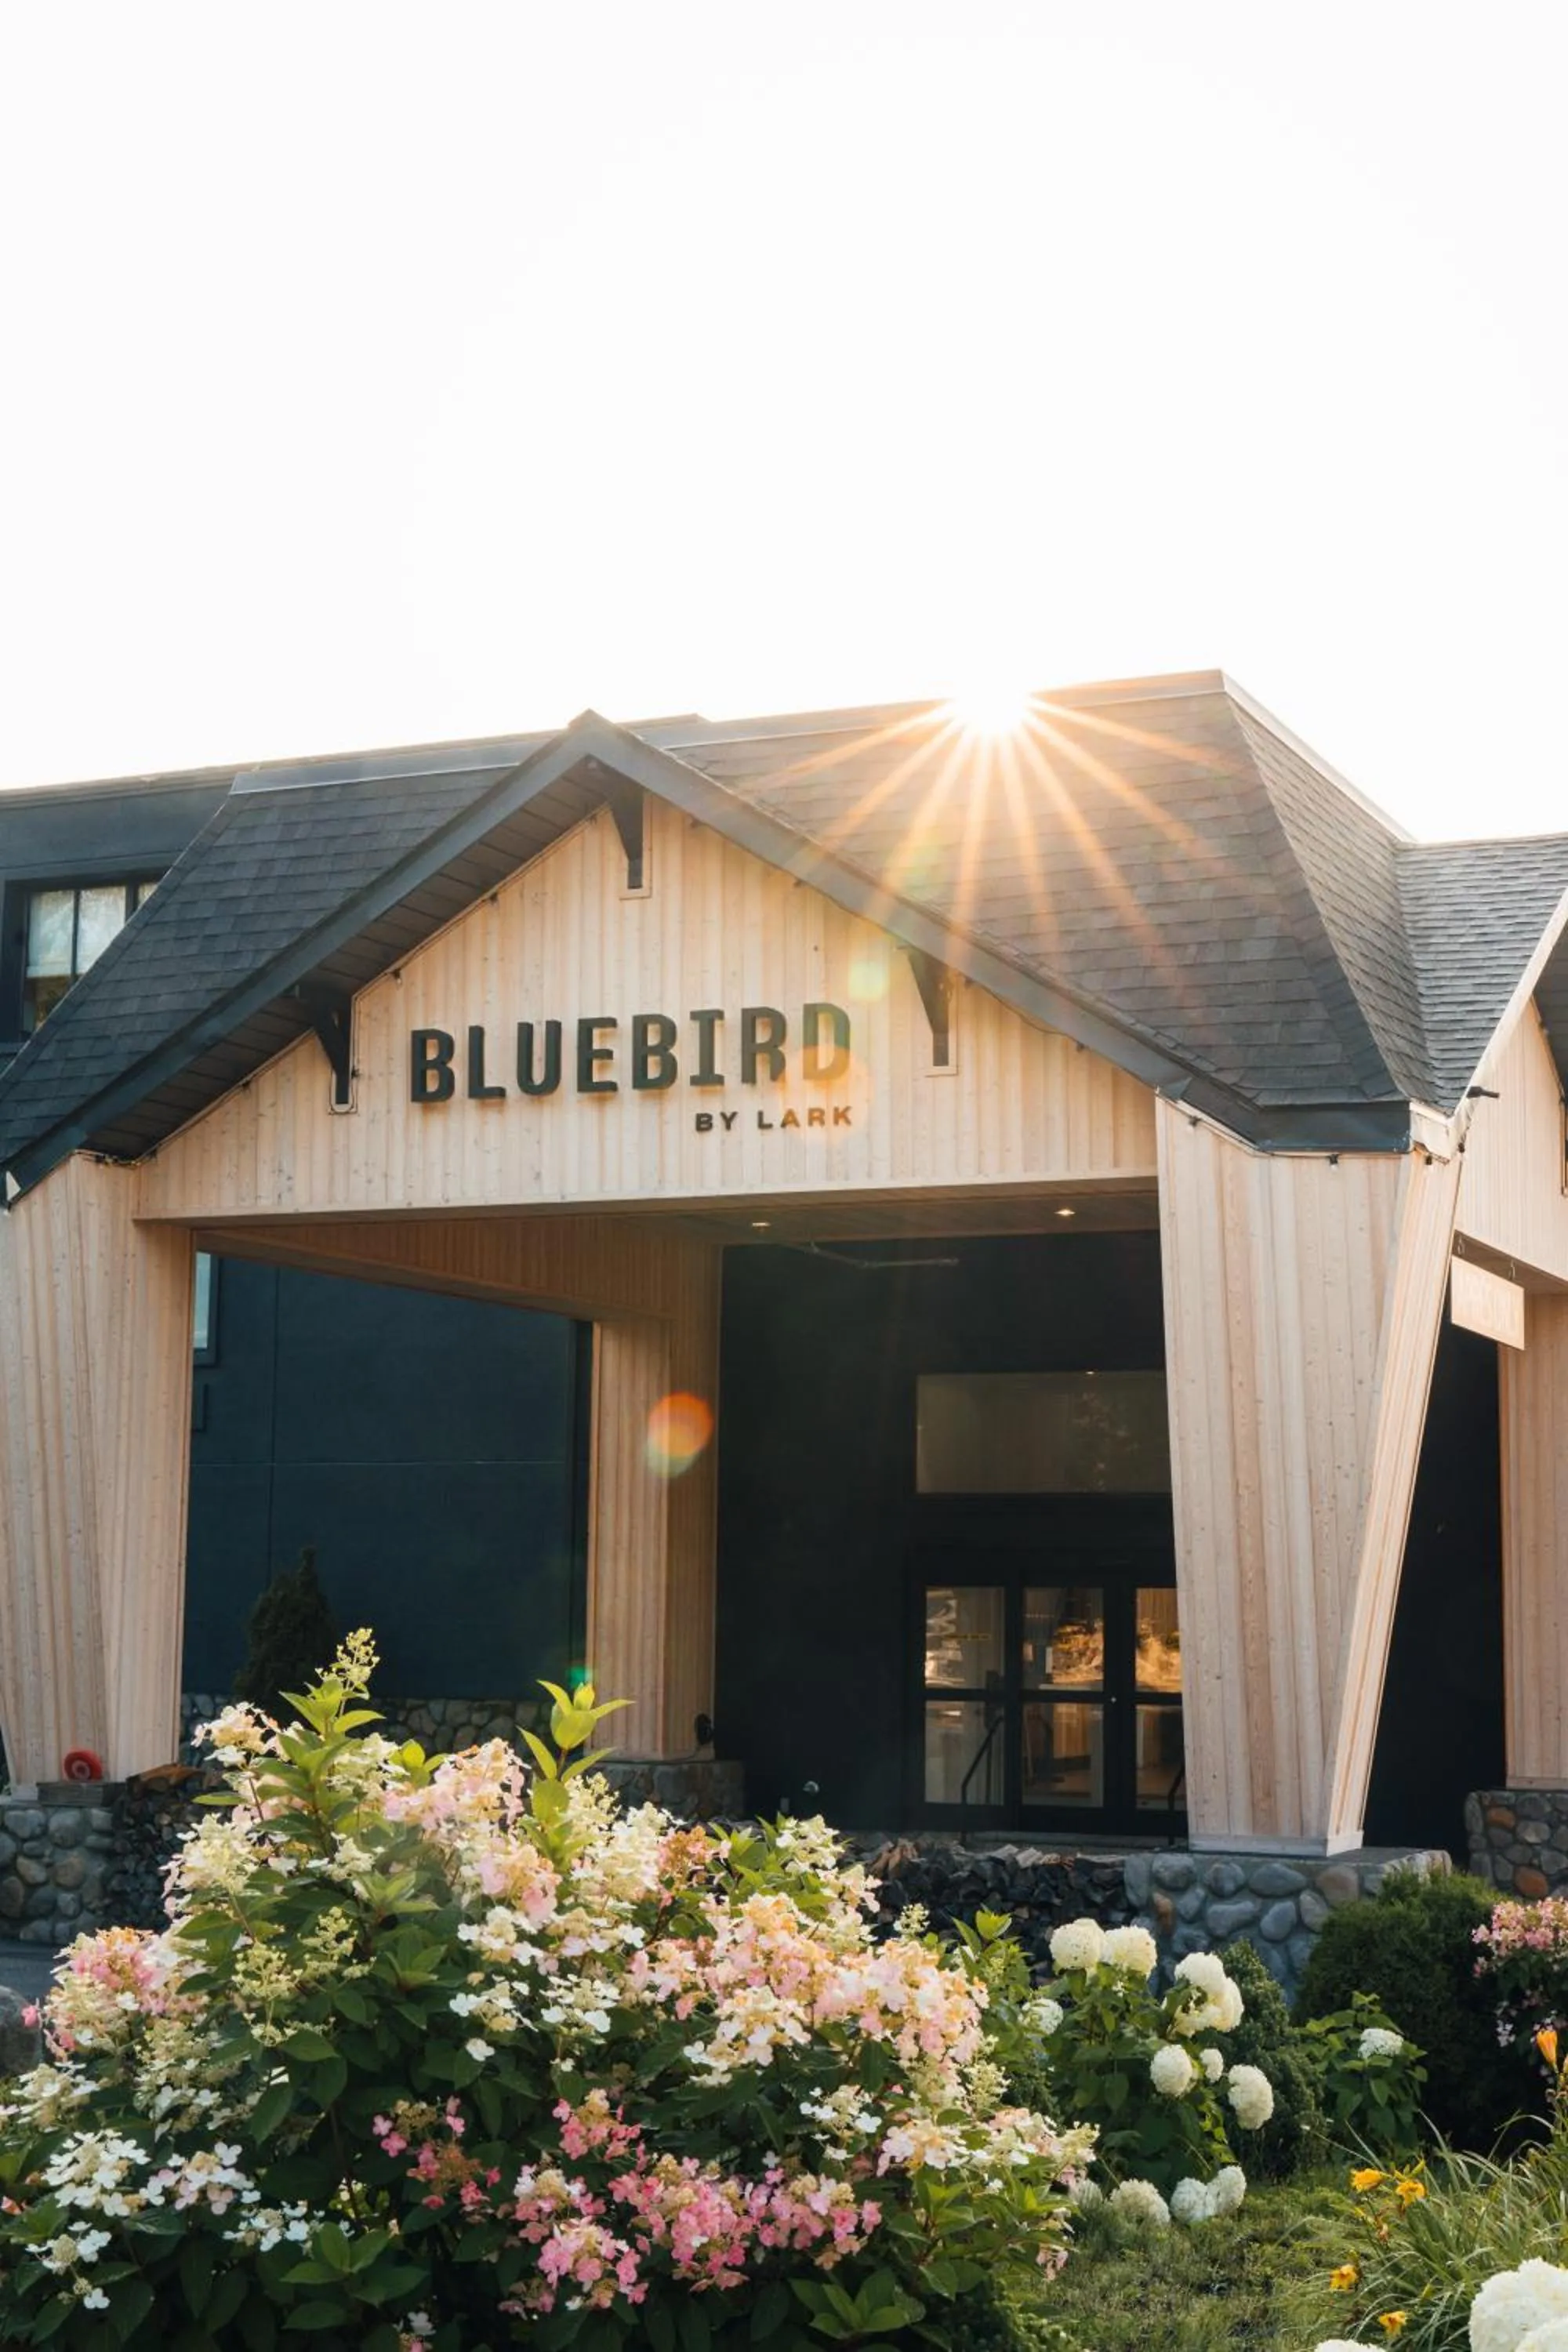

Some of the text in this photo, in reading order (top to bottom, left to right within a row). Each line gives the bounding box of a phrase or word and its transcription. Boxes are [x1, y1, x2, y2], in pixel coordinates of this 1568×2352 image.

[411, 1002, 851, 1102] BLUEBIRD
[695, 1105, 852, 1131] BY LARK
